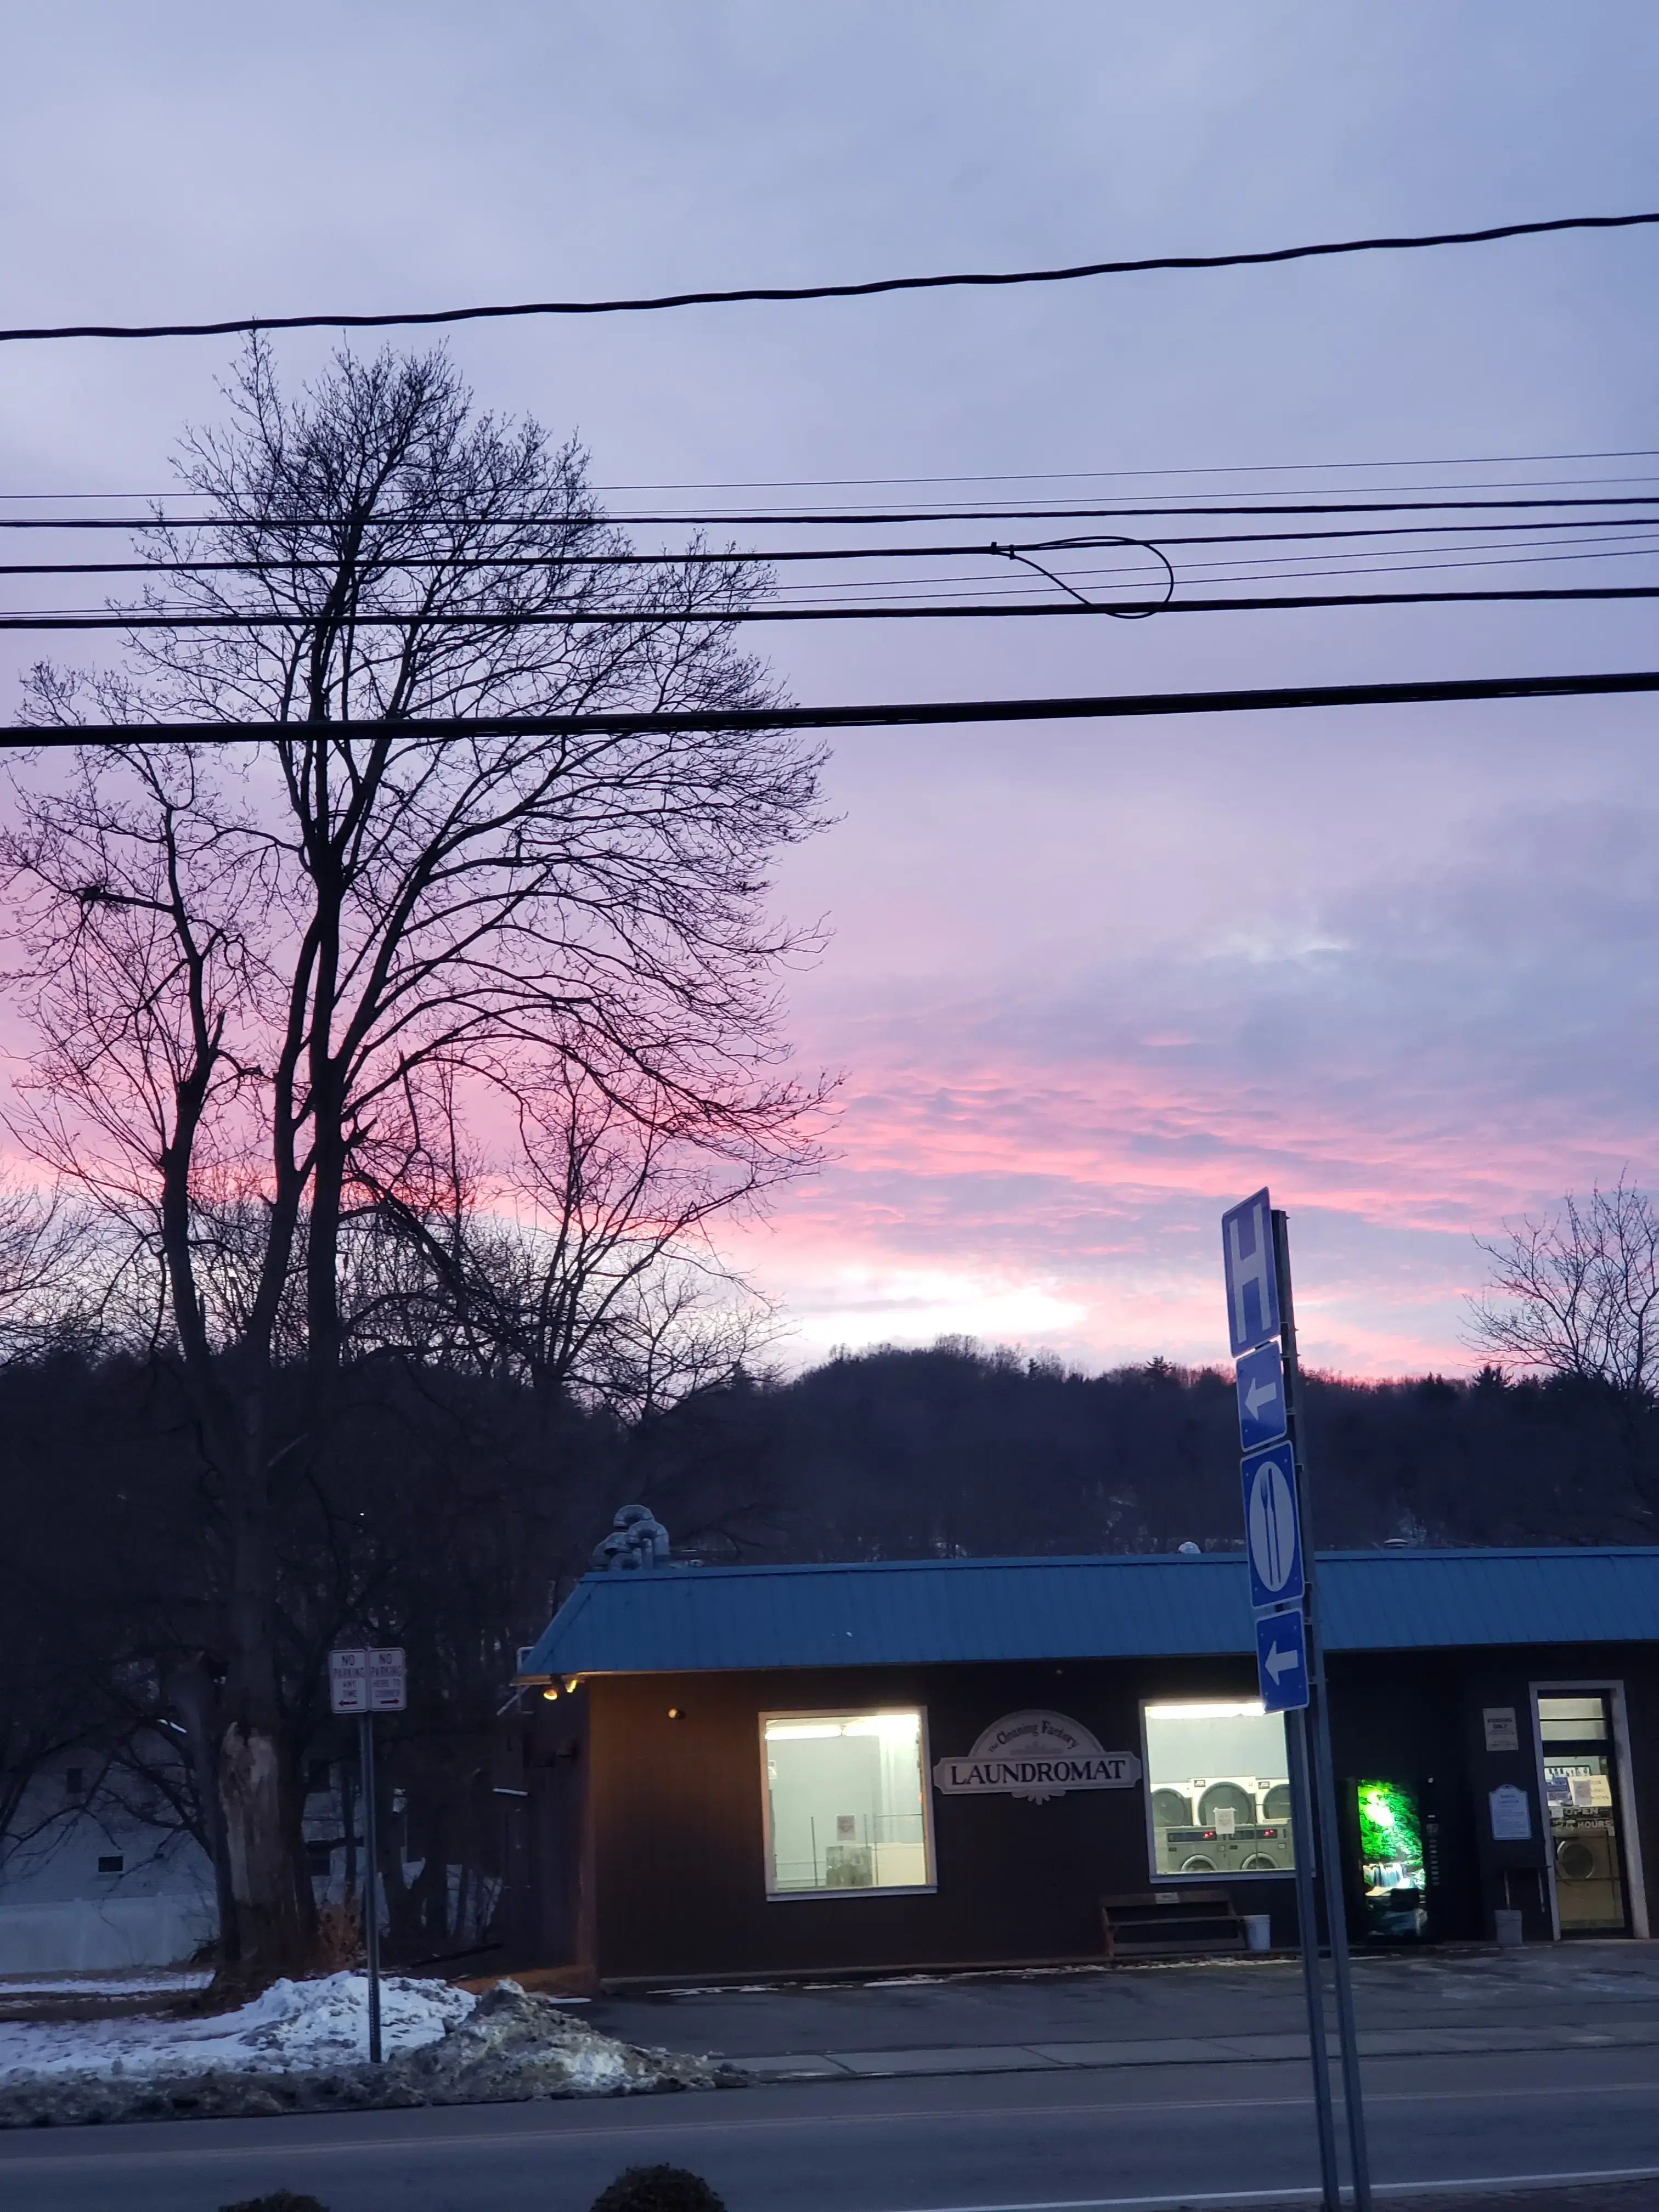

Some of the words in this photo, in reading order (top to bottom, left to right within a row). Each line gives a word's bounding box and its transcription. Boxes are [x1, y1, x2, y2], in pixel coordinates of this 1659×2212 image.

[1229, 1203, 1272, 1344] H
[342, 1655, 355, 1666] NO
[379, 1653, 392, 1664] NO
[996, 1724, 1039, 1745] Cleaning
[1041, 1720, 1080, 1750] Factory
[951, 1760, 1125, 1785] LAUNDROMAT
[1564, 1807, 1599, 1815] OPEN
[1577, 1819, 1611, 1829] HOURS
